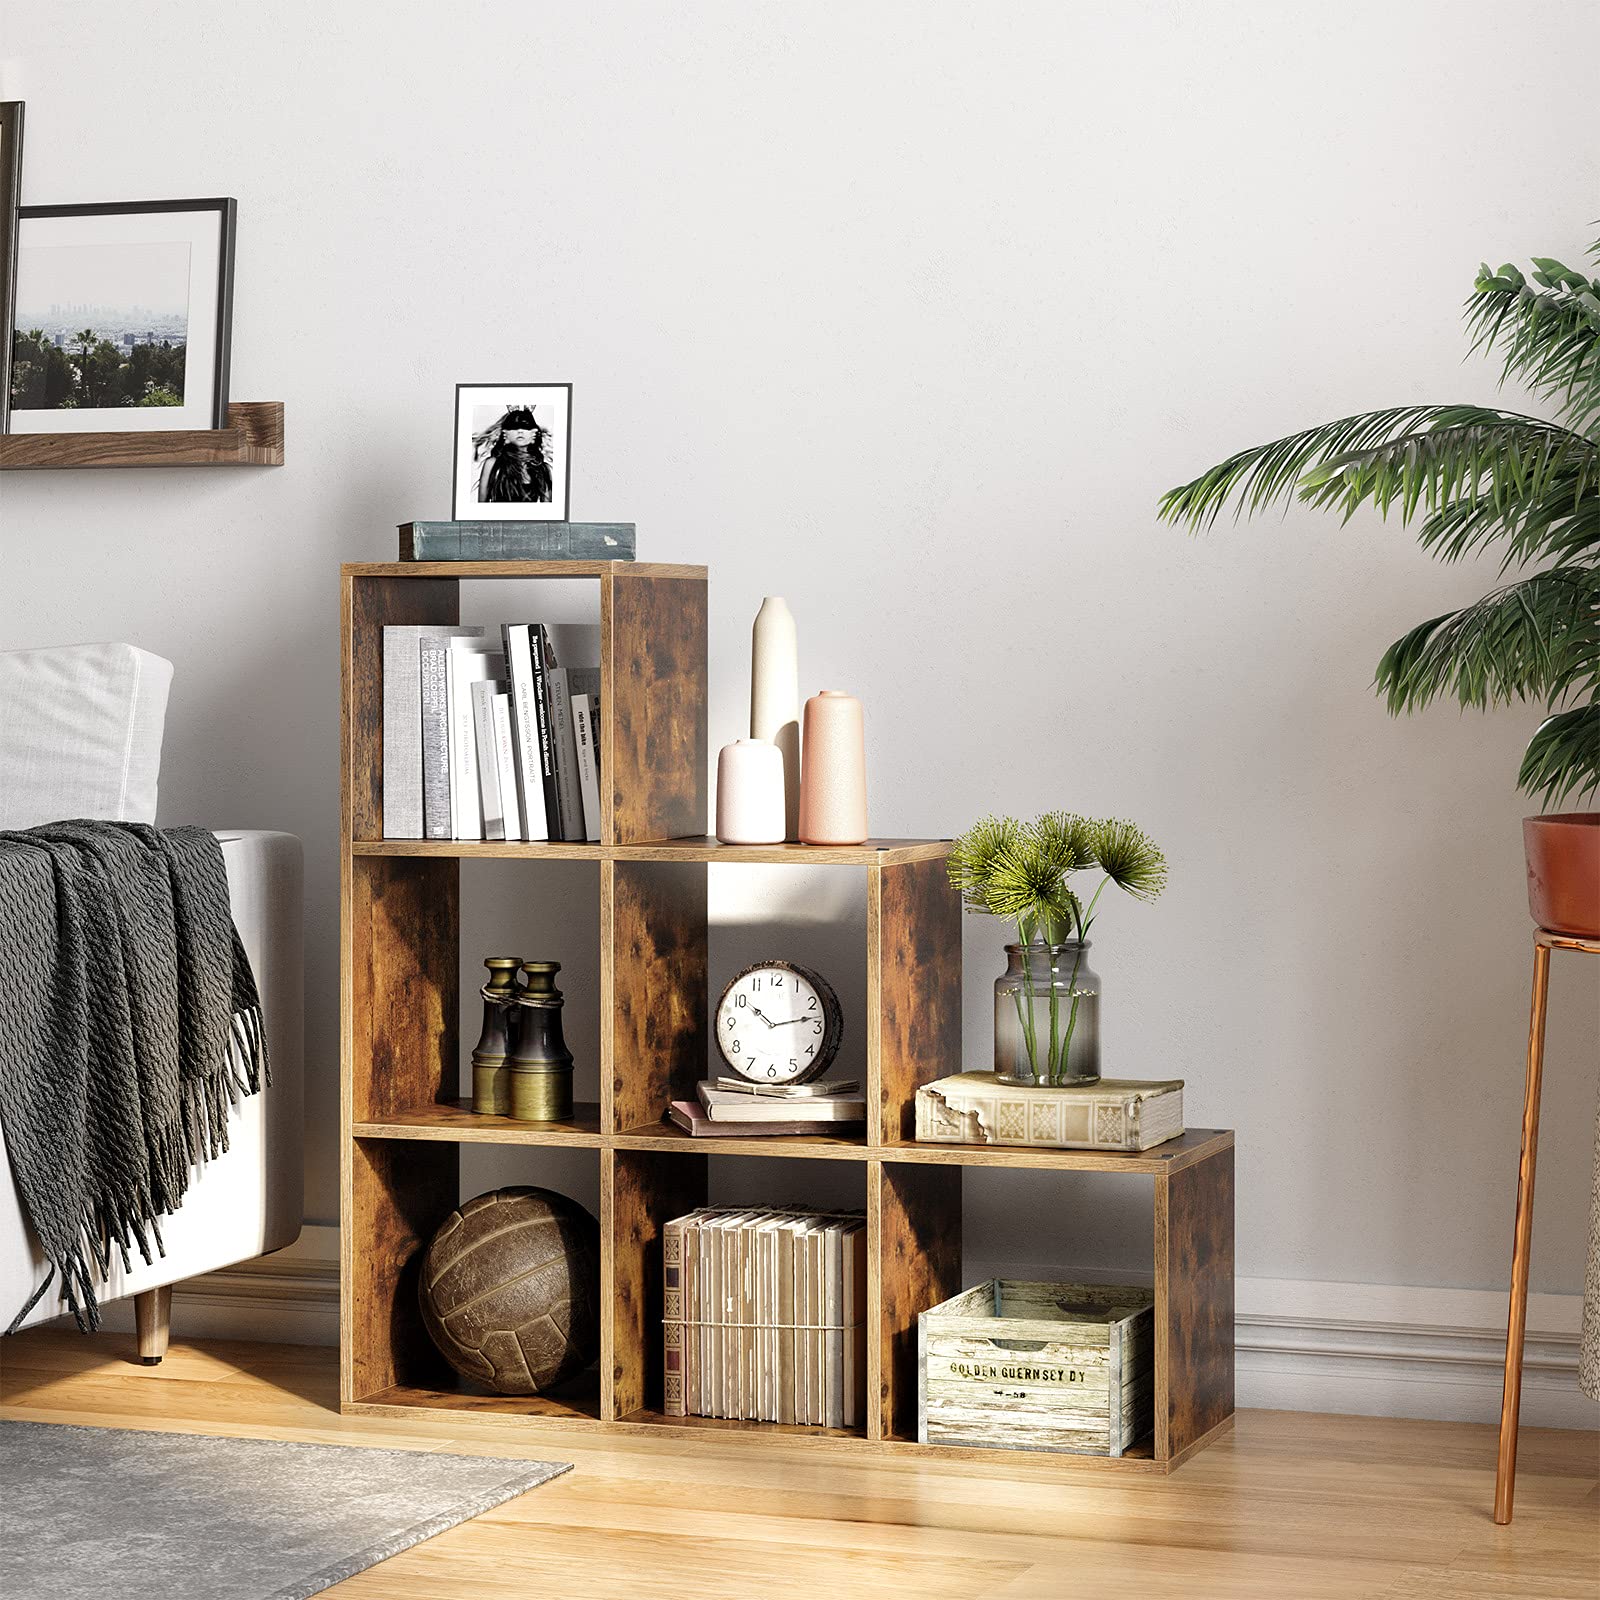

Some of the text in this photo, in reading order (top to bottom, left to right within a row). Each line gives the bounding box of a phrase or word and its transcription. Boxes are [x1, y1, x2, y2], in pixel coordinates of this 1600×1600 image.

[422, 650, 430, 704] OCCUPATION
[438, 649, 449, 774] ALLIED WORKS ARCHITECTURE
[523, 701, 532, 743] BENGTSSON
[527, 745, 535, 784] PORTRAITS
[752, 978, 761, 991] 11
[771, 972, 783, 986] 12
[795, 979, 799, 993] 1
[735, 994, 747, 1008] 10
[807, 996, 817, 1010] 2
[727, 1017, 736, 1031] 9
[812, 1020, 822, 1034] 3
[732, 1040, 741, 1053] 8
[804, 1044, 815, 1057] 4
[747, 1057, 756, 1071] 7
[767, 1063, 776, 1078] 6
[788, 1058, 798, 1073] 5
[950, 1362, 996, 1377] GOLDEN
[1001, 1367, 1064, 1381] GUERNSEY
